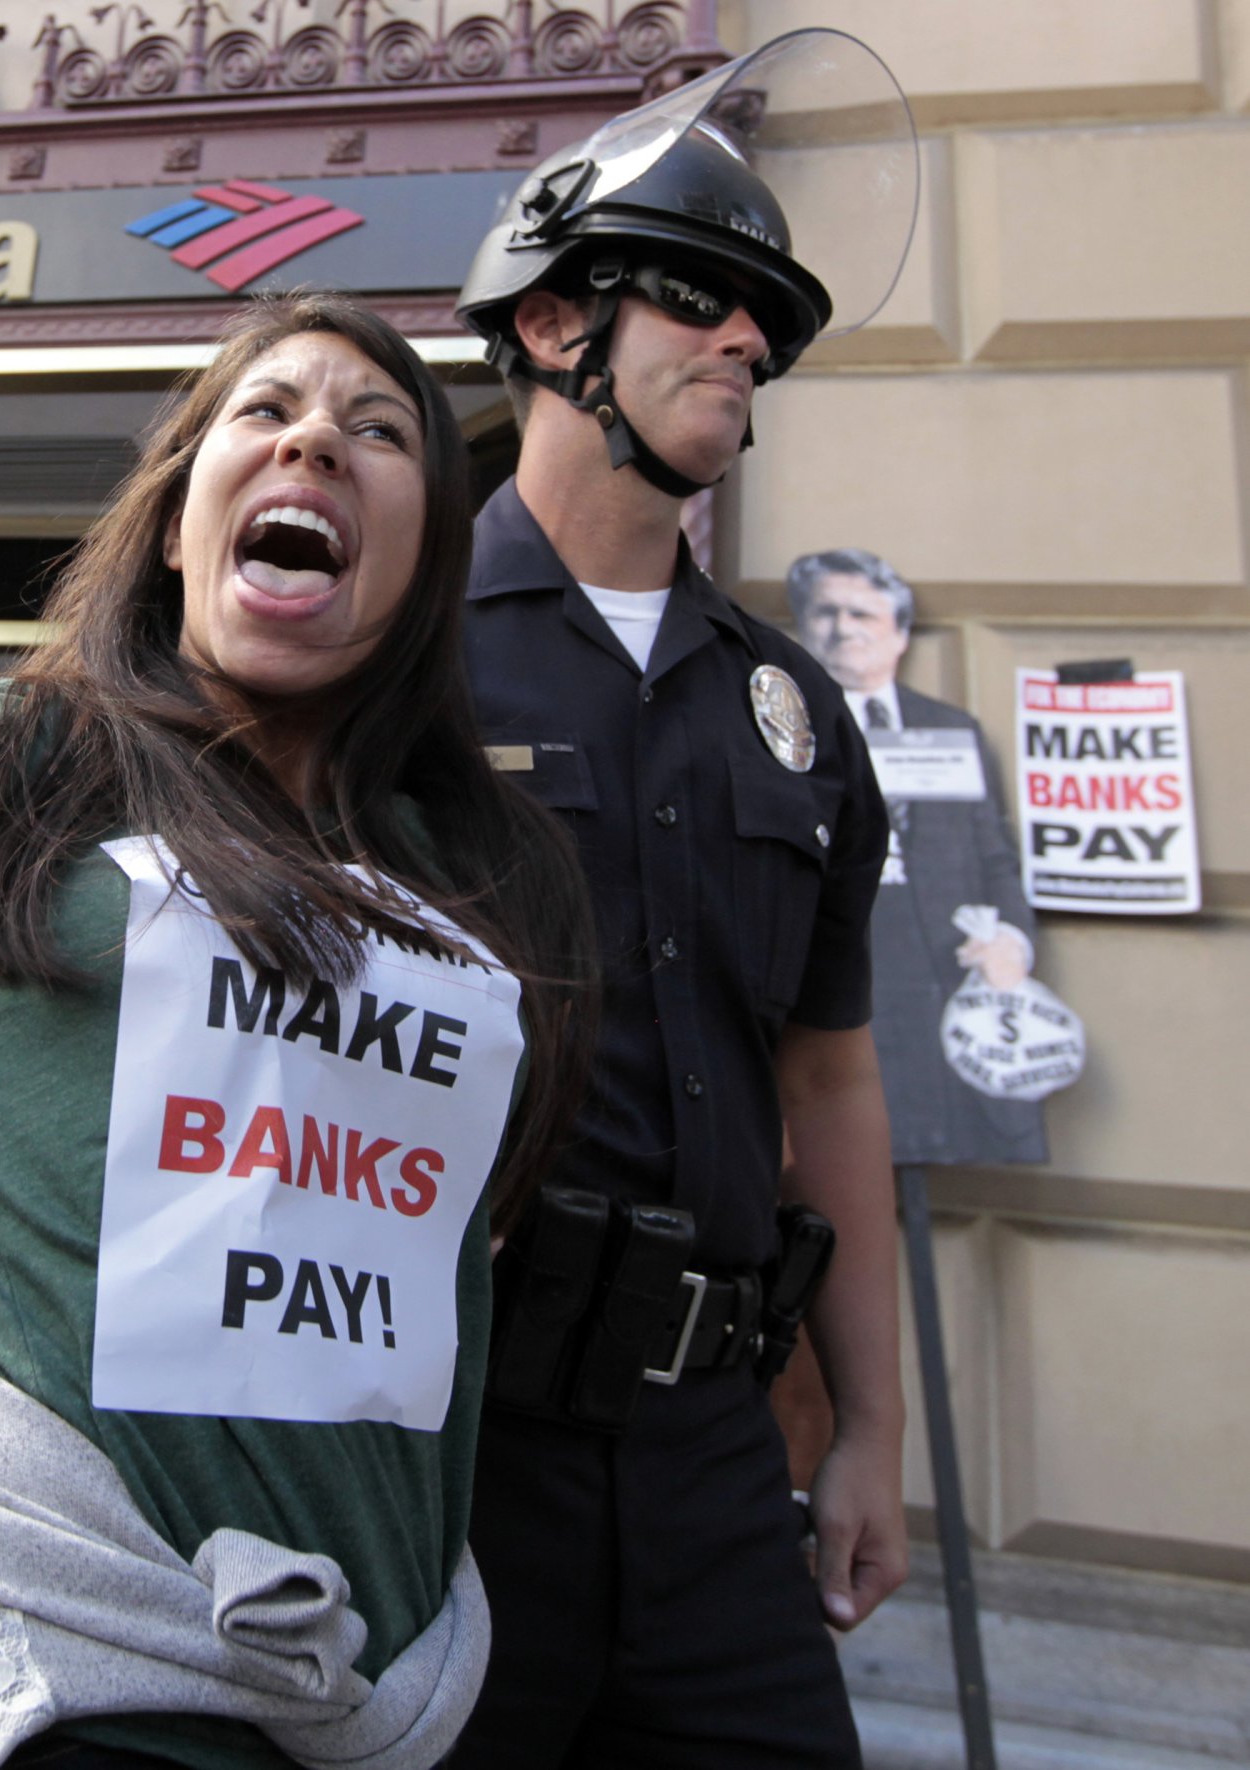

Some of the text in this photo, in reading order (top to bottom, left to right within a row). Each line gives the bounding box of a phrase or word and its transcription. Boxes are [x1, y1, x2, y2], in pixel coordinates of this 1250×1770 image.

[1026, 724, 1178, 760] MAKE
[1027, 772, 1182, 811] BANKS
[1031, 822, 1182, 861] PAY
[207, 956, 468, 1088] MAKE
[158, 1094, 446, 1217] BANKS
[221, 1249, 396, 1349] PAY!
